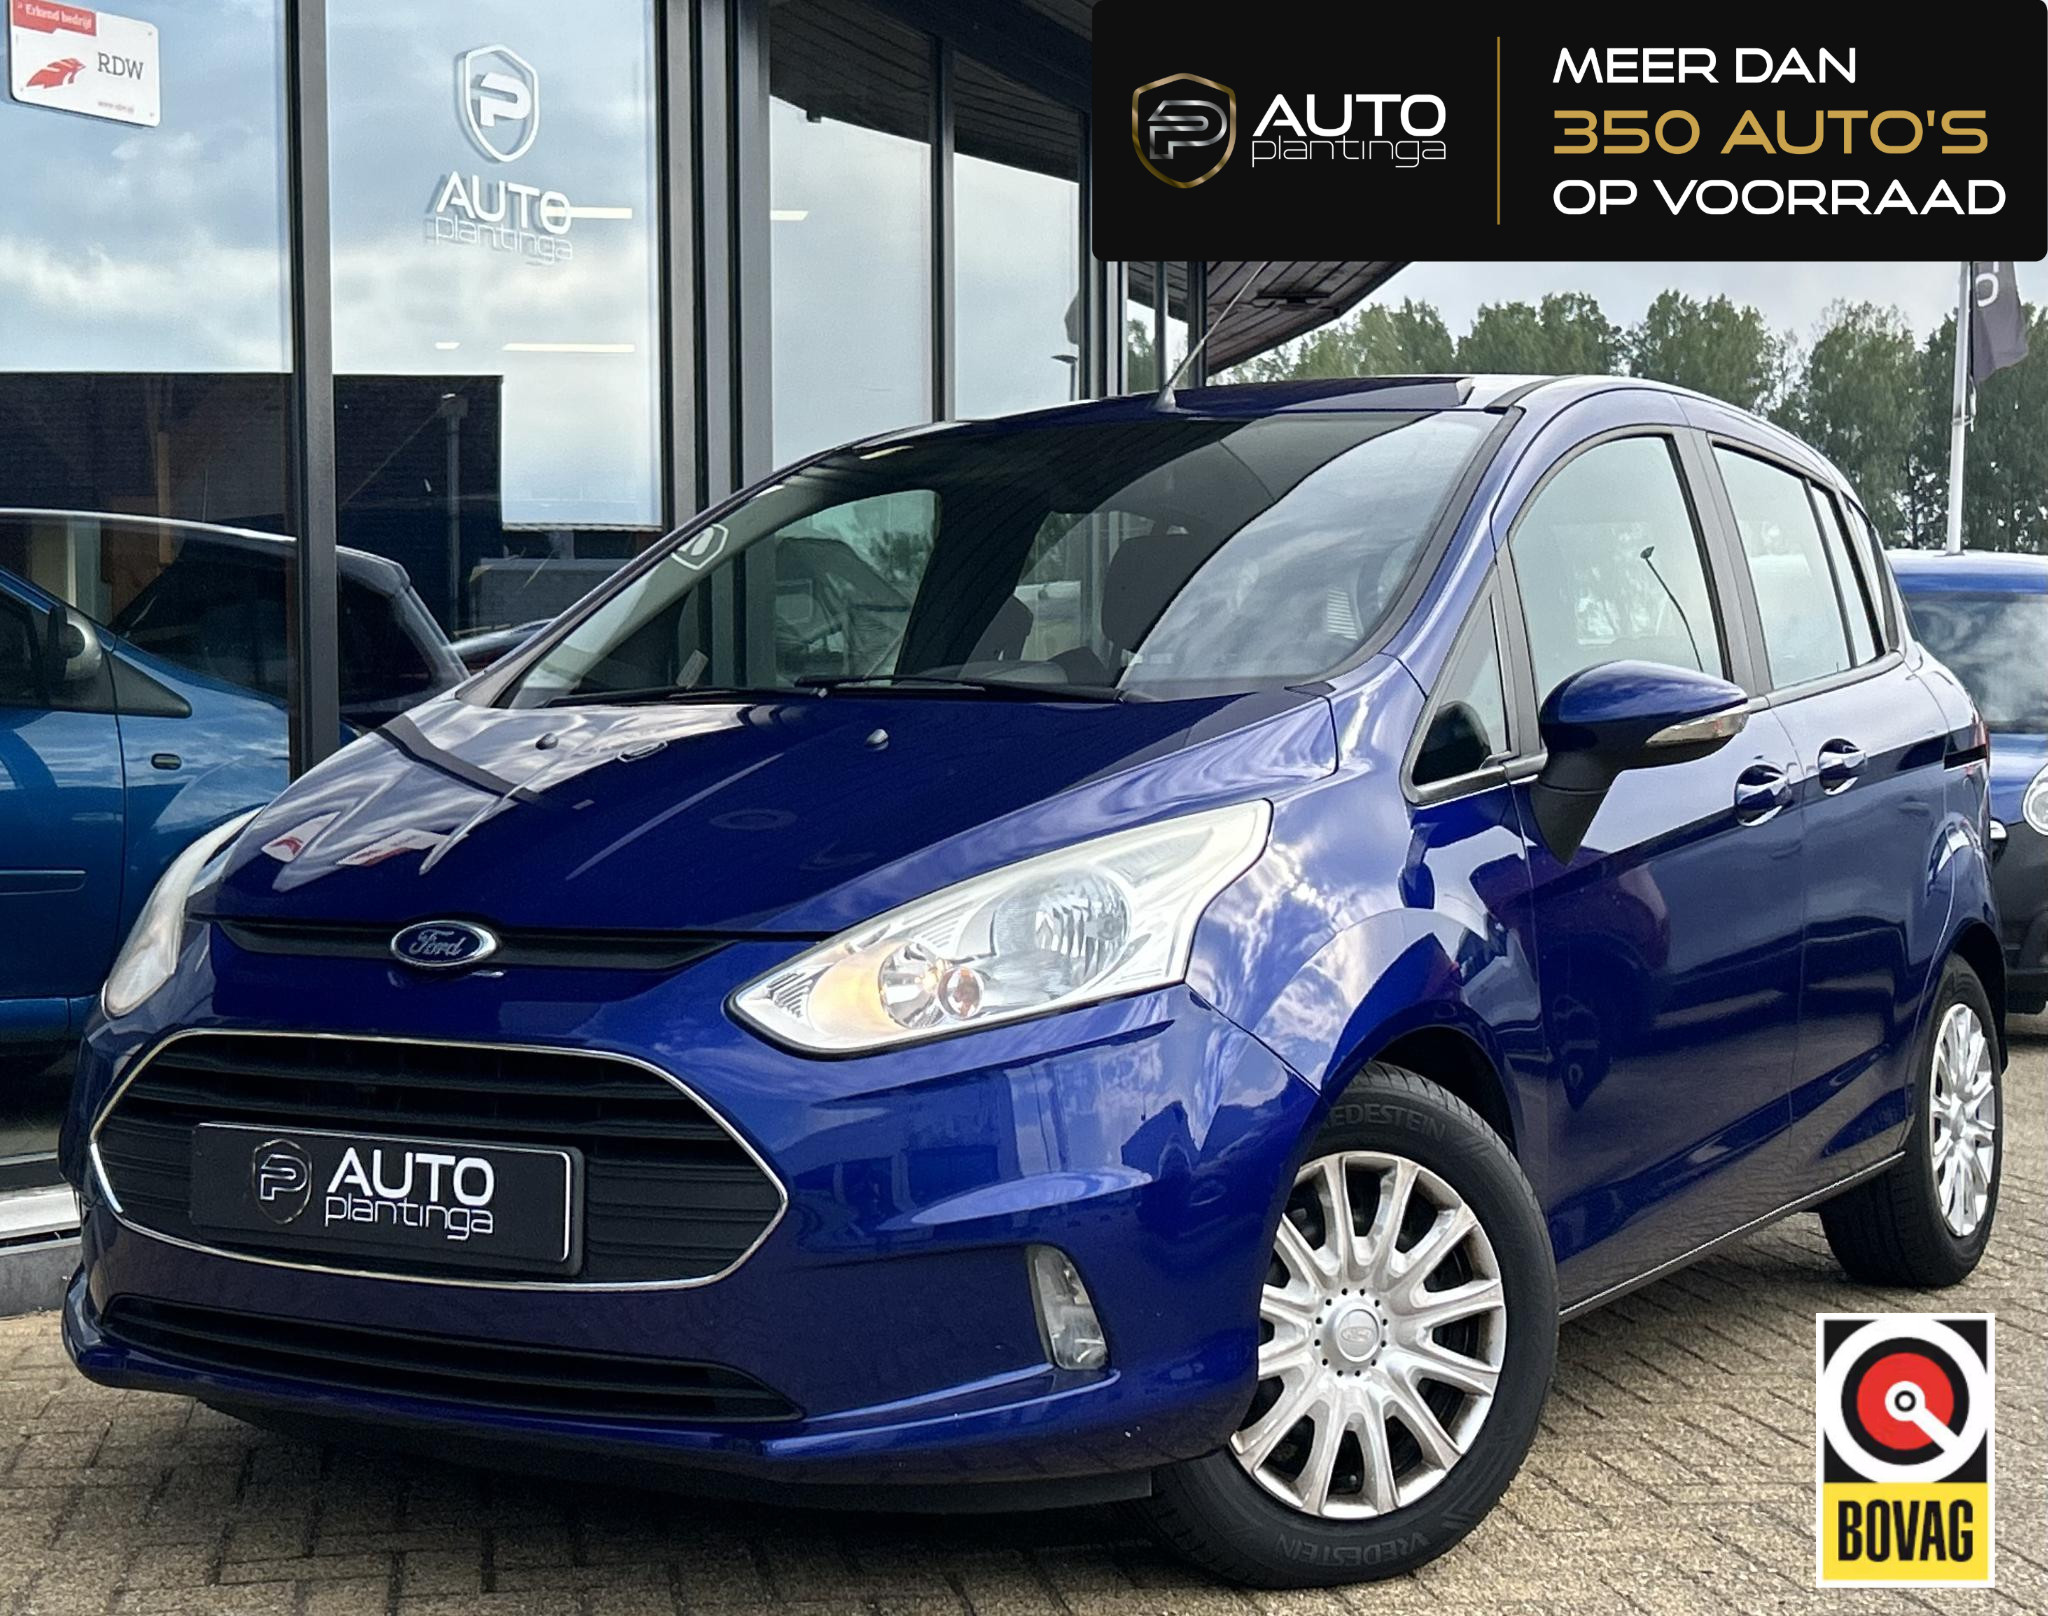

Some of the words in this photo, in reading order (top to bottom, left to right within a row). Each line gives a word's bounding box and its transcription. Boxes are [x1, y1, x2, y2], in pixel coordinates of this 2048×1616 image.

[97, 52, 144, 80] RDW
[436, 171, 571, 235] AUTO
[434, 215, 573, 265] plantinga
[409, 929, 467, 956] Ford
[1322, 1103, 1446, 1138] EDESTEIN
[327, 1147, 495, 1207] AUTO
[325, 1194, 494, 1241] plantinga
